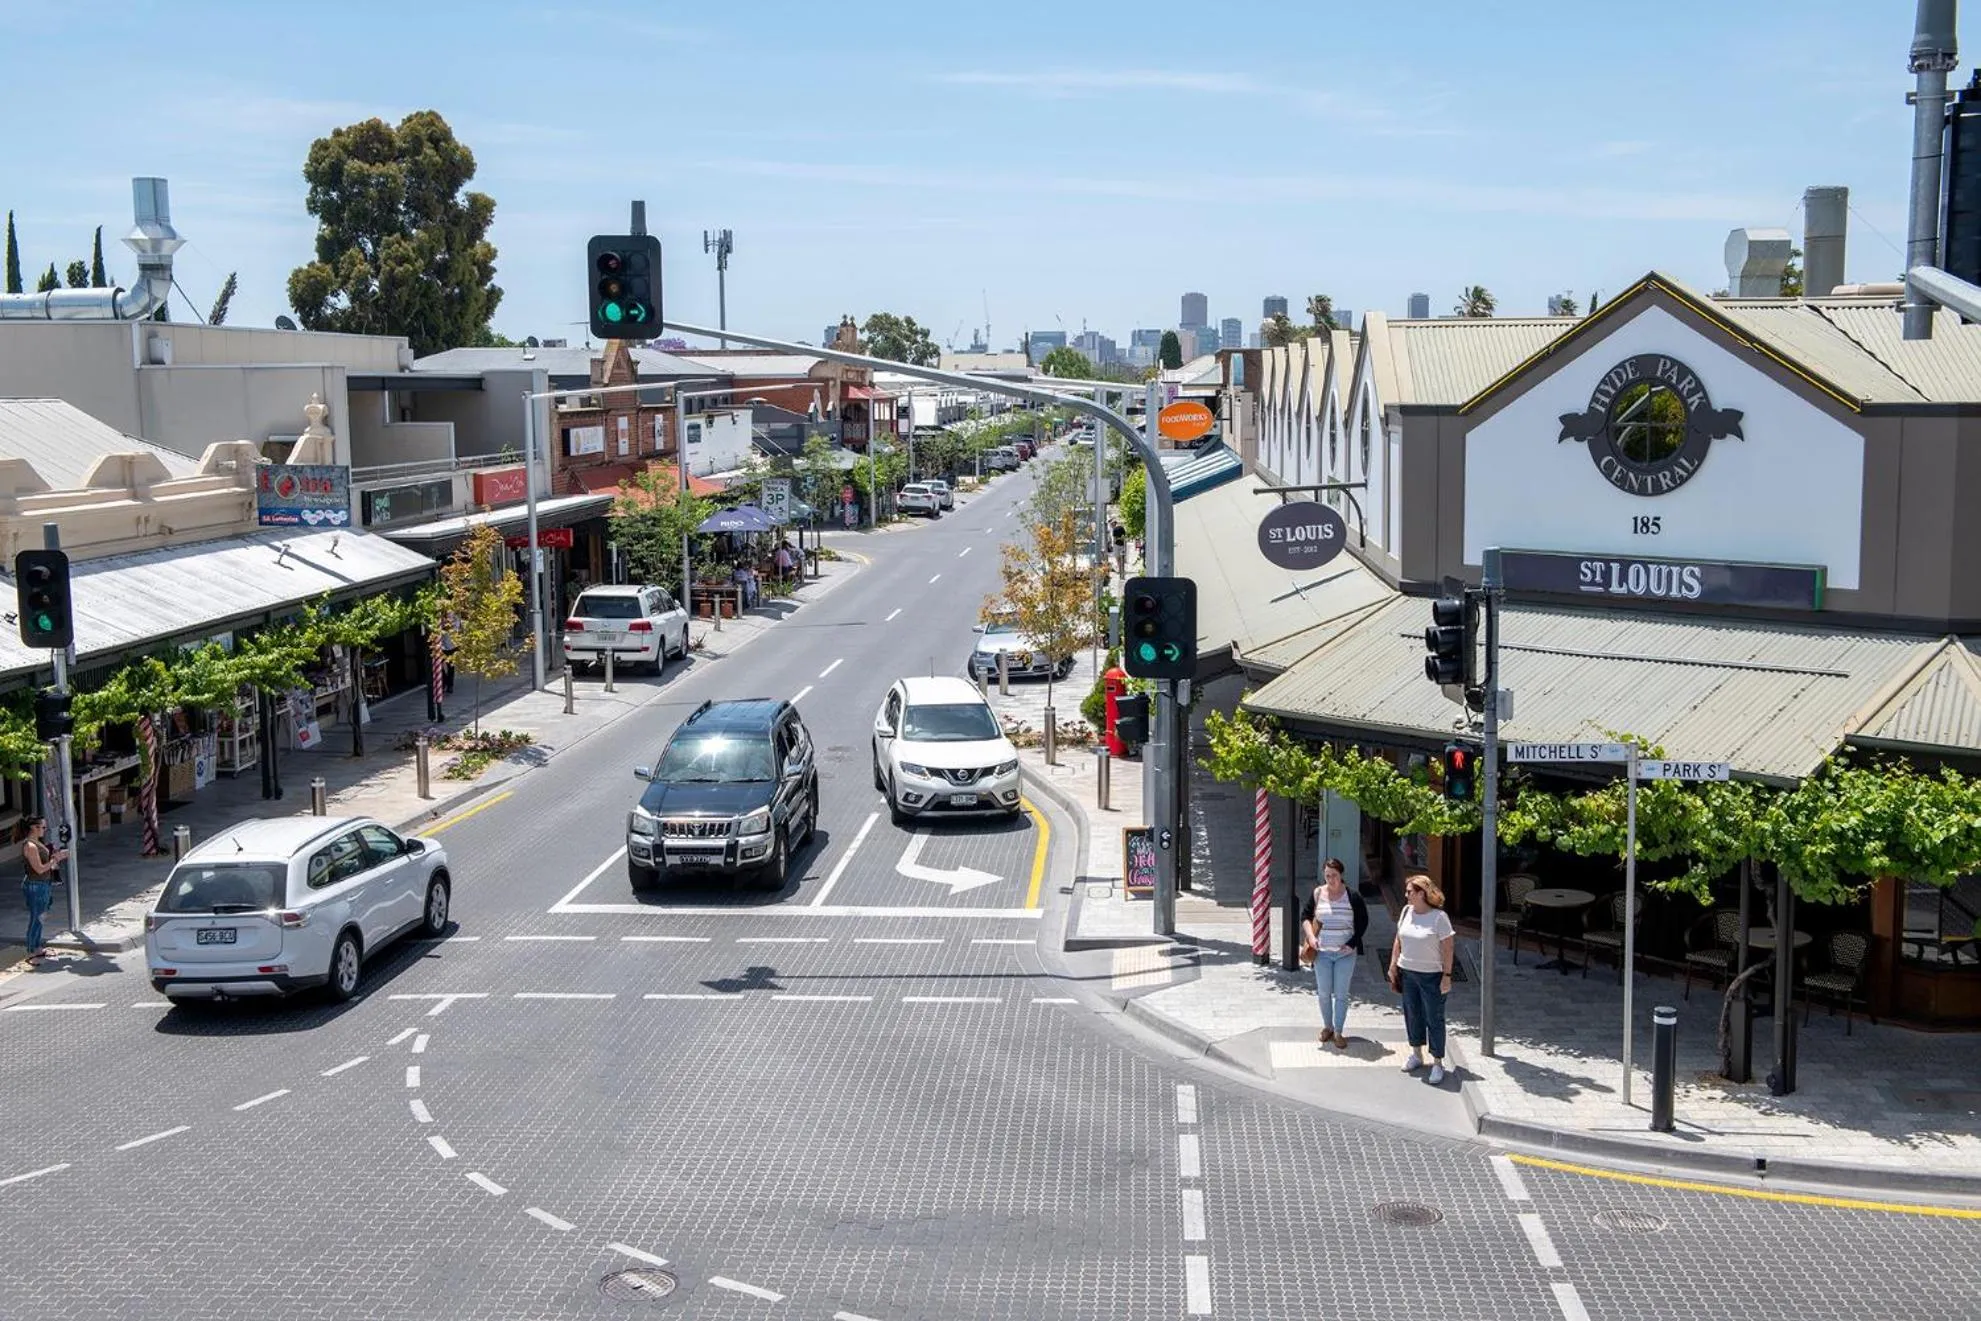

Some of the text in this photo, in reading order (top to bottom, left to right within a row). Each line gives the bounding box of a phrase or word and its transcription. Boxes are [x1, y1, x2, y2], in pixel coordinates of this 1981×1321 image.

[1590, 357, 1706, 413] HYDE PARK
[1600, 455, 1698, 494] CENTRAL
[766, 493, 785, 505] 3P
[1269, 524, 1334, 542] ST LOUIS
[1632, 516, 1661, 535] 185
[1580, 561, 1701, 599] ST LOUIS
[1515, 745, 1584, 760] MITCHELL
[1663, 763, 1700, 778] PARK
